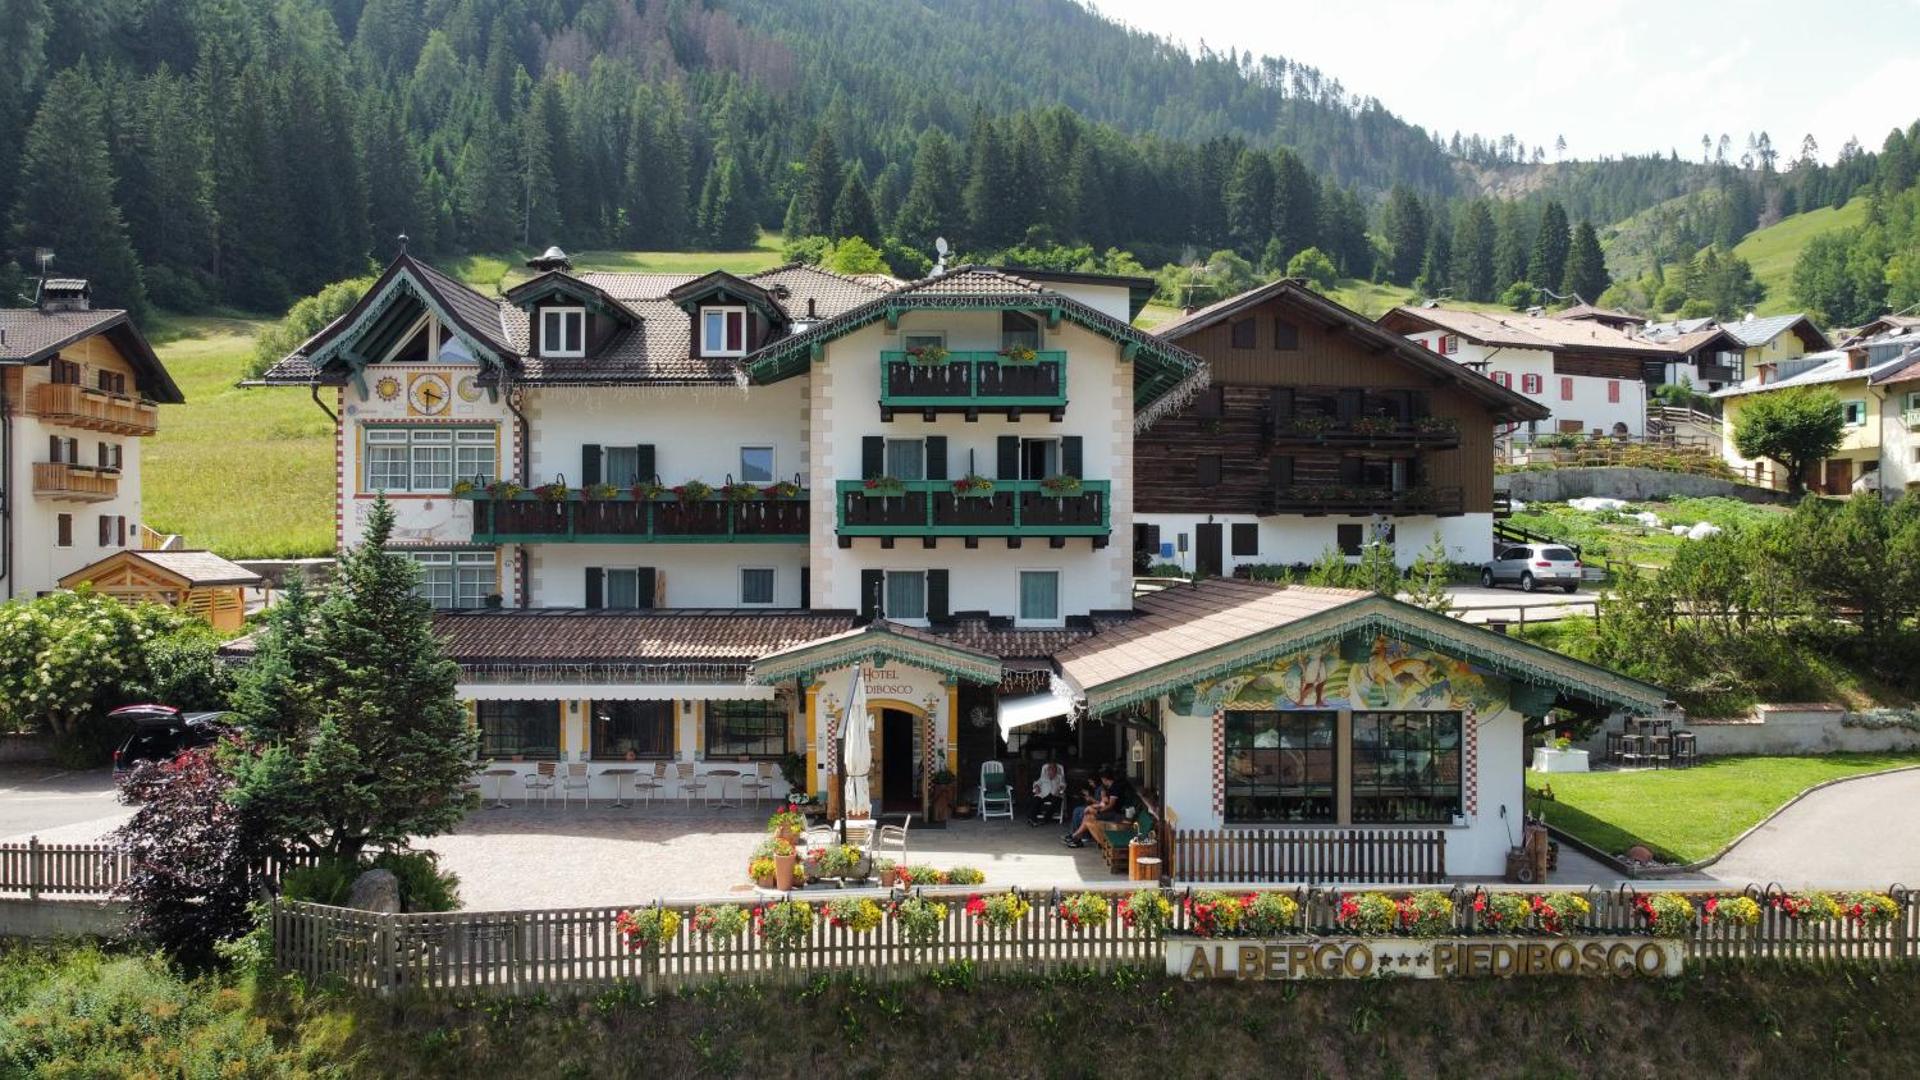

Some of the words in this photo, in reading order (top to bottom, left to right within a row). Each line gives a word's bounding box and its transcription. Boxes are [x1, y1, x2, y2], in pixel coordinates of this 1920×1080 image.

[864, 685, 913, 695] DIBOSCO
[1187, 943, 1374, 978] ALBERGO
[1434, 942, 1667, 977] PIEDIBOSCO
